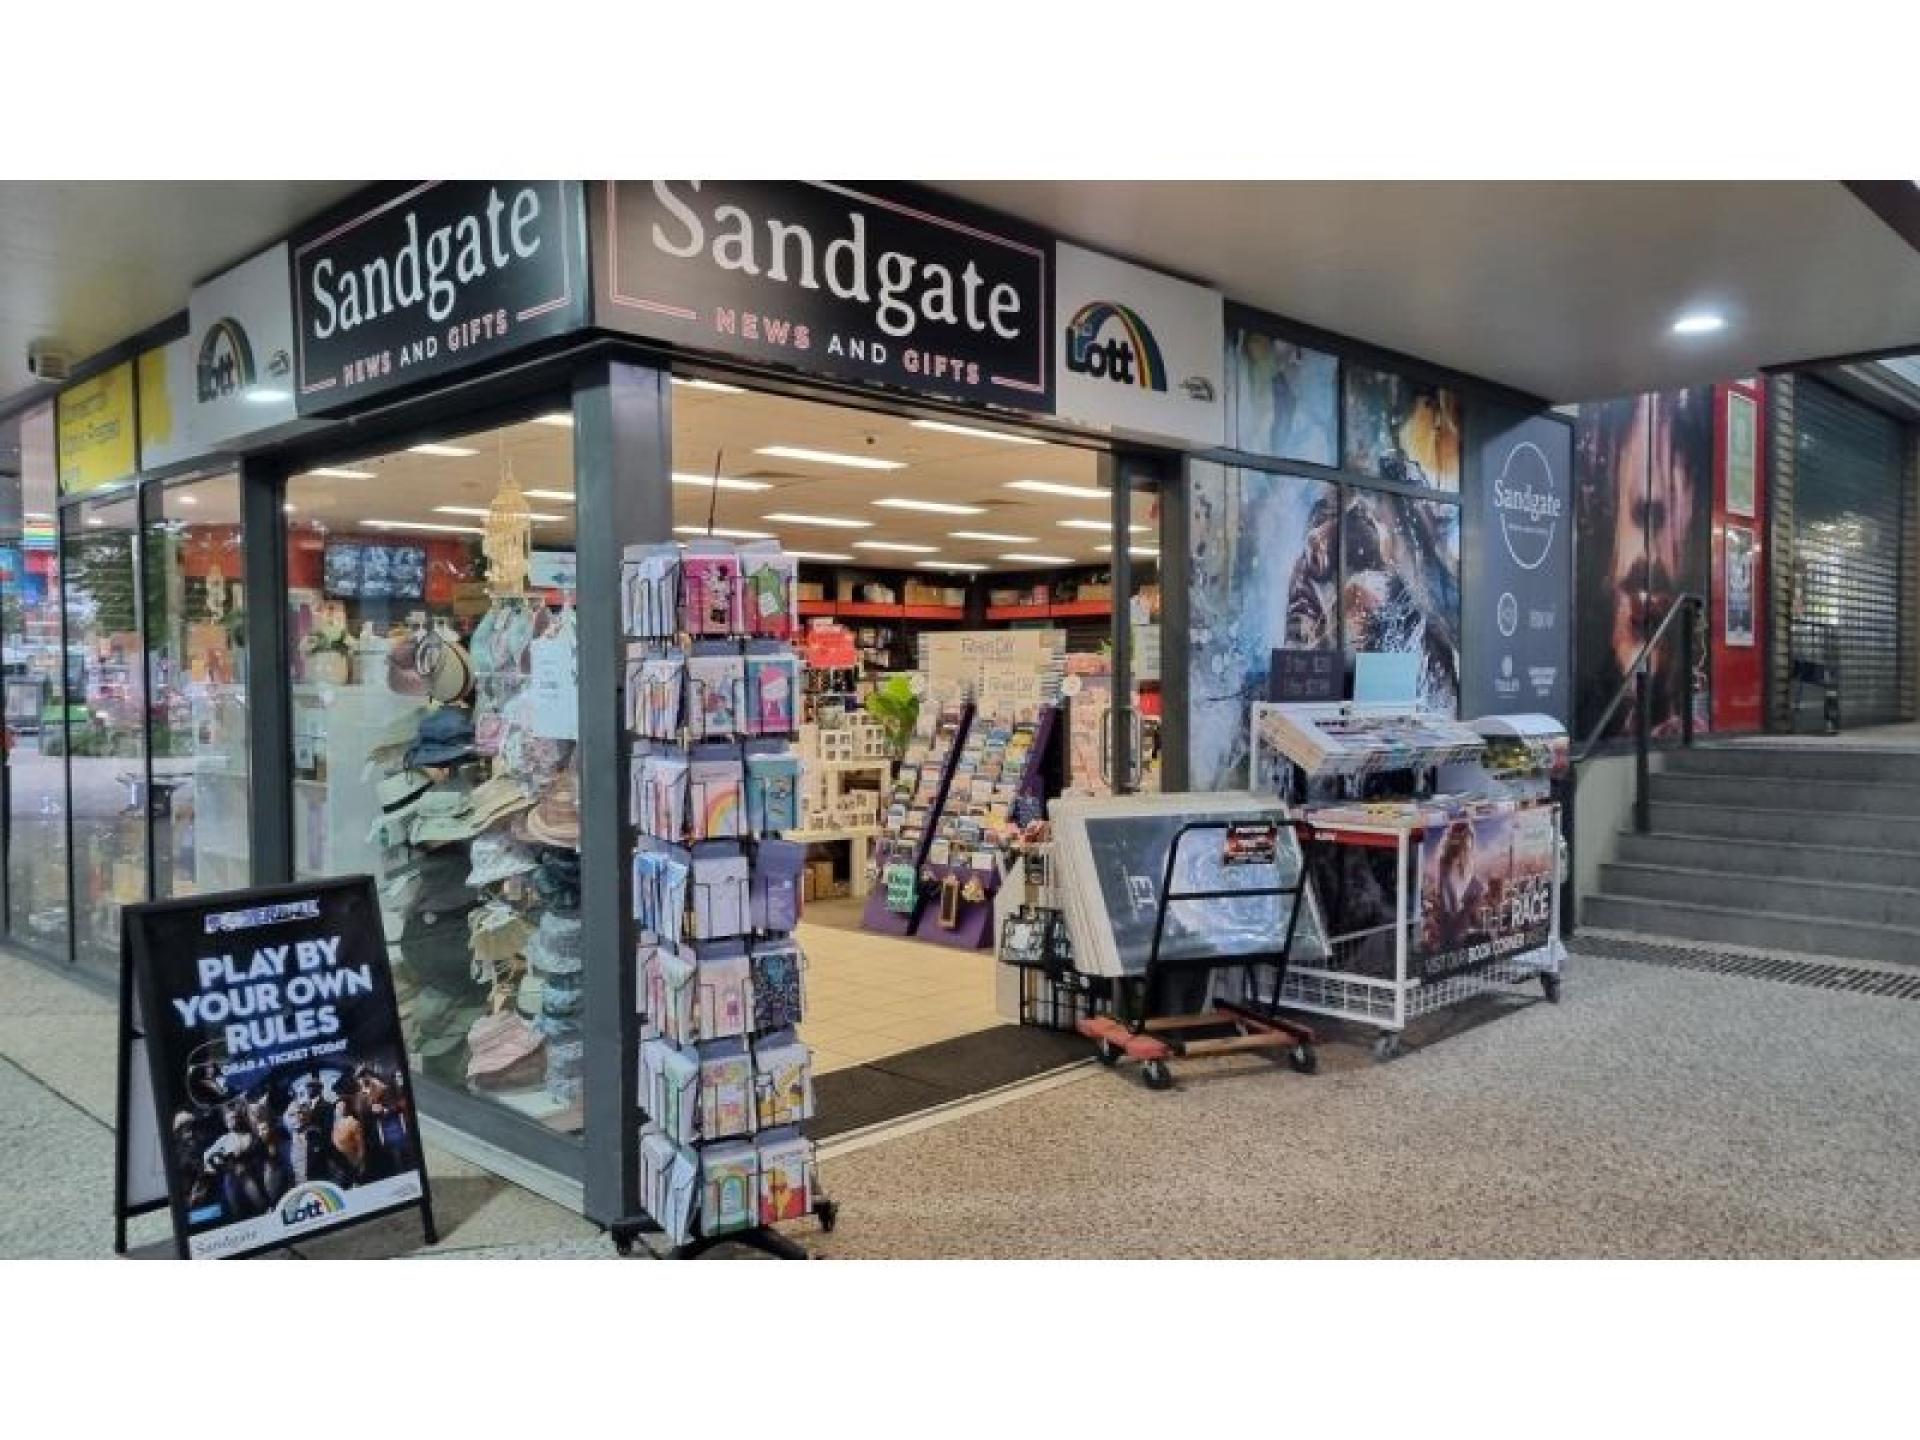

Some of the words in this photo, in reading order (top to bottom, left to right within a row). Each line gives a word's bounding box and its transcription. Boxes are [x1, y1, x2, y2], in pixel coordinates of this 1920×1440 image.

[313, 187, 541, 339] Sandgate
[652, 181, 1022, 339] Sandgate
[343, 350, 392, 388] NEWS
[400, 336, 438, 367] AND
[447, 309, 508, 352] GIFTS
[716, 306, 810, 349] NEWS
[827, 333, 887, 364] AND
[903, 349, 980, 385] GIFTS
[1494, 479, 1561, 522] Sandgate
[173, 983, 281, 1028] YOUR
[287, 964, 373, 1005] OWN
[198, 945, 289, 988] PLAY
[295, 935, 341, 971] BY
[226, 1005, 341, 1055] RULES
